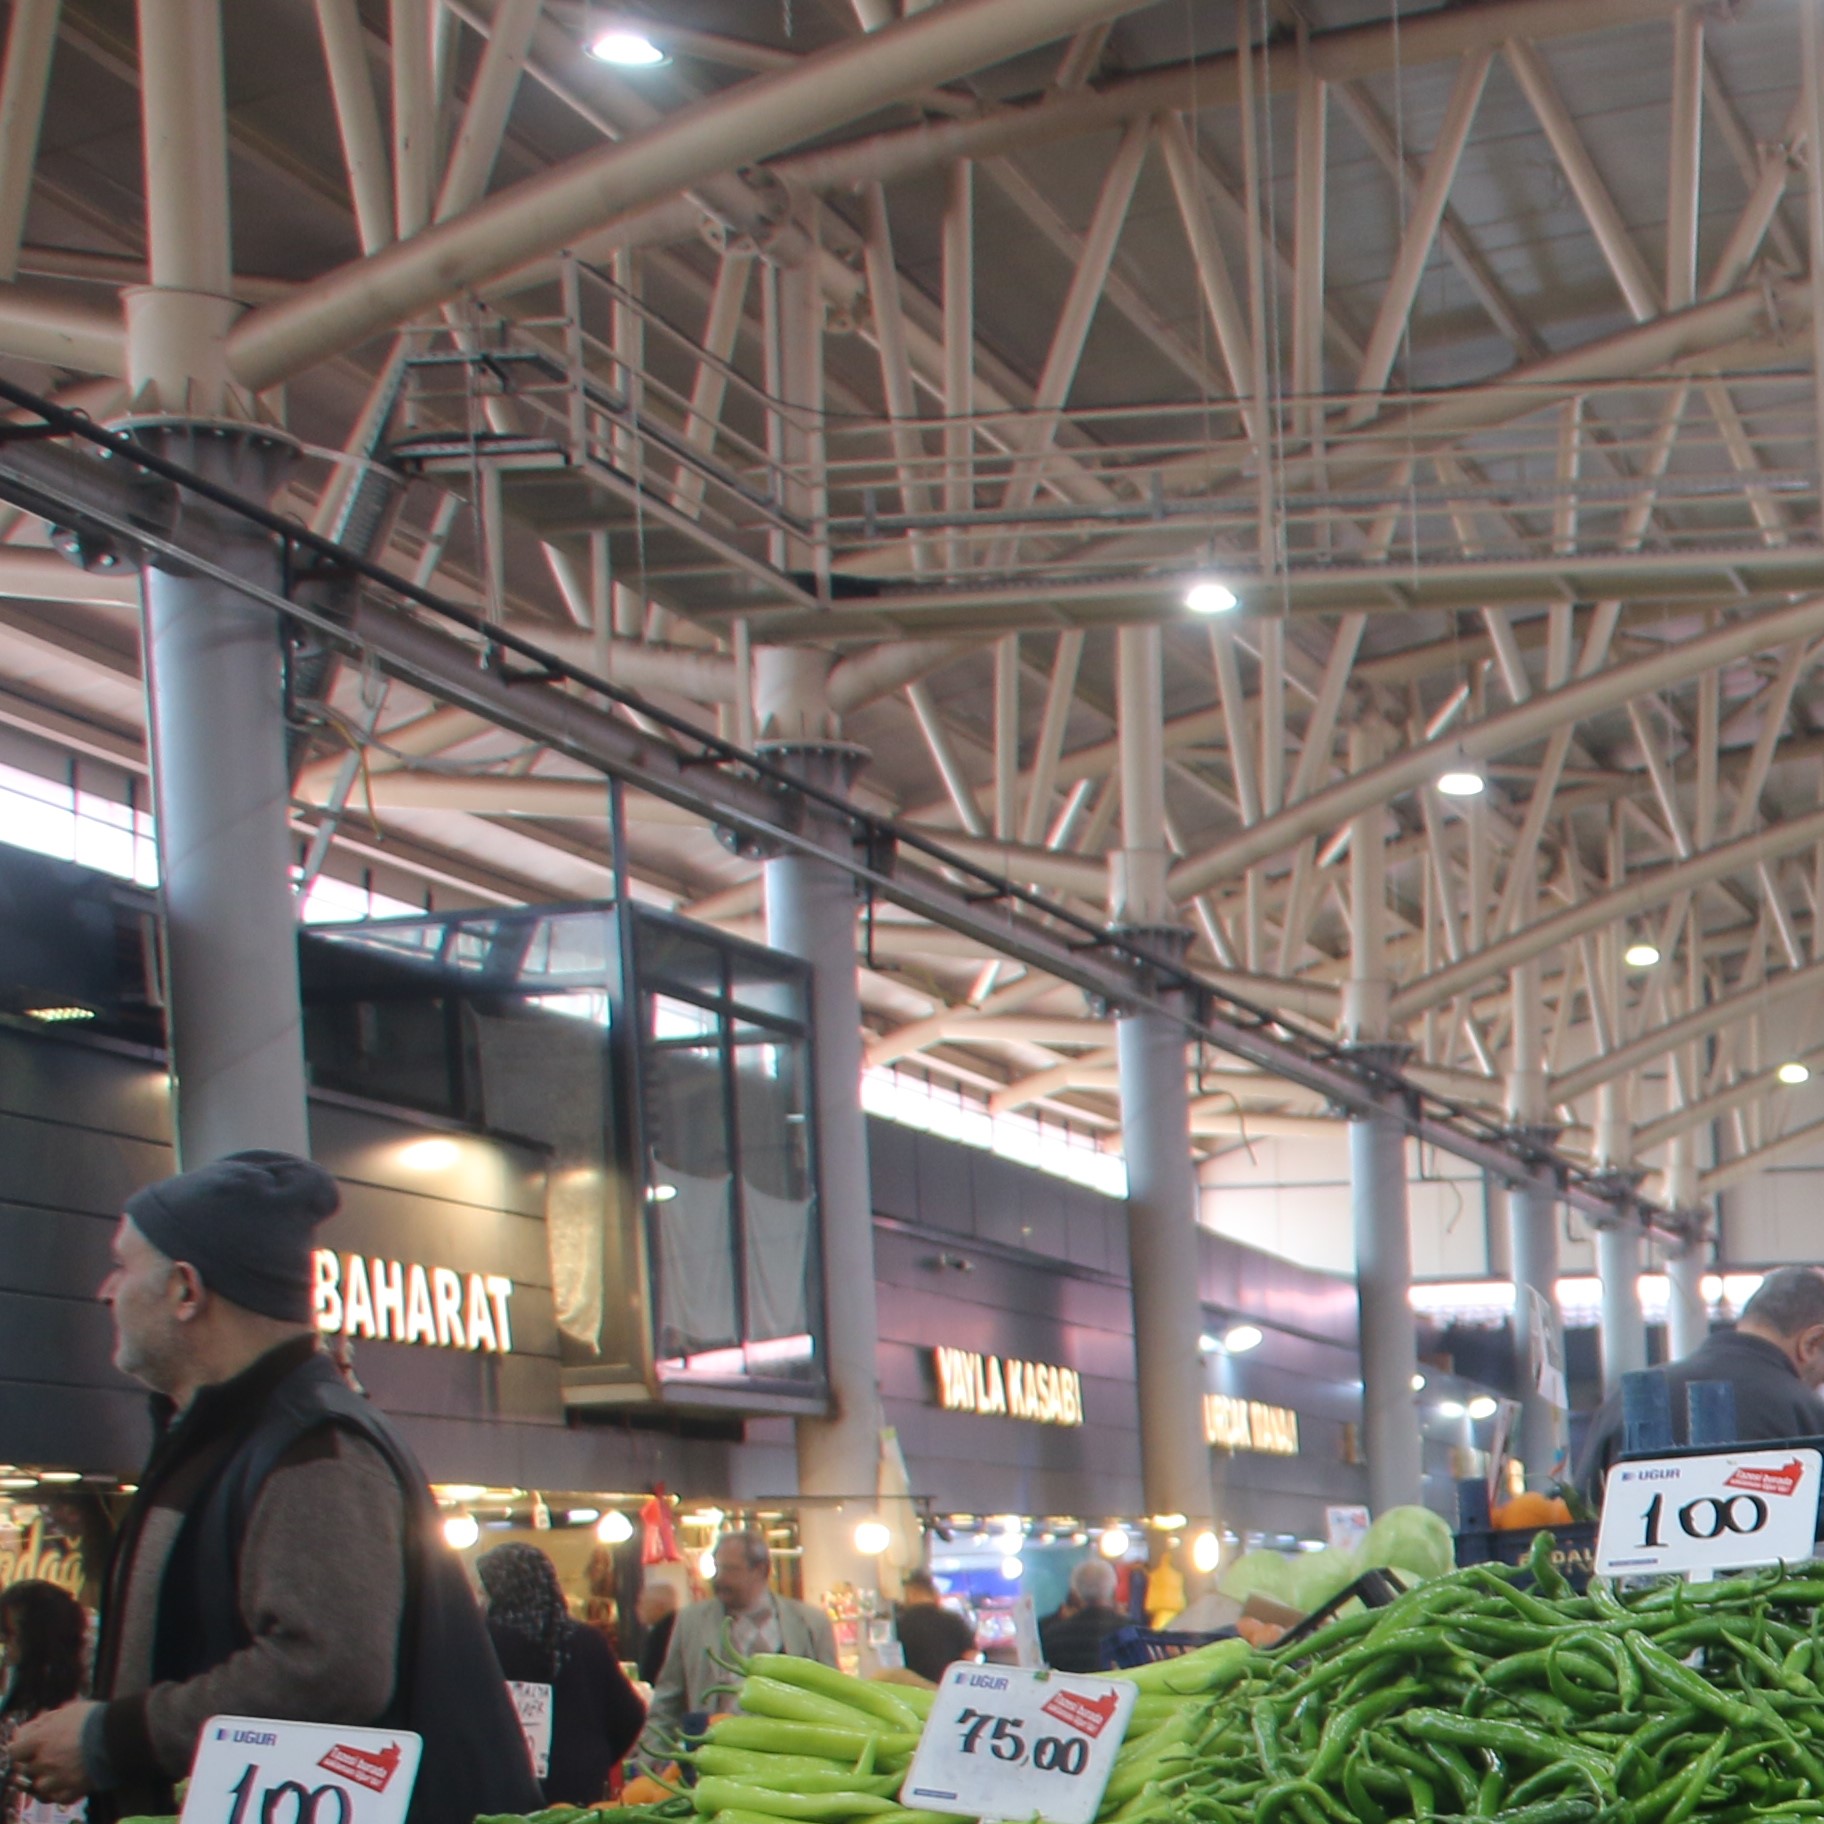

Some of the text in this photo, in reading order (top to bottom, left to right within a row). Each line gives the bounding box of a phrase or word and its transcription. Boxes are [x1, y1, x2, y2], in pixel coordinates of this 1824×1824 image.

[312, 1248, 514, 1353] BAHARAT
[1635, 1493, 1769, 1549] 100
[957, 1707, 1090, 1777] 75,00
